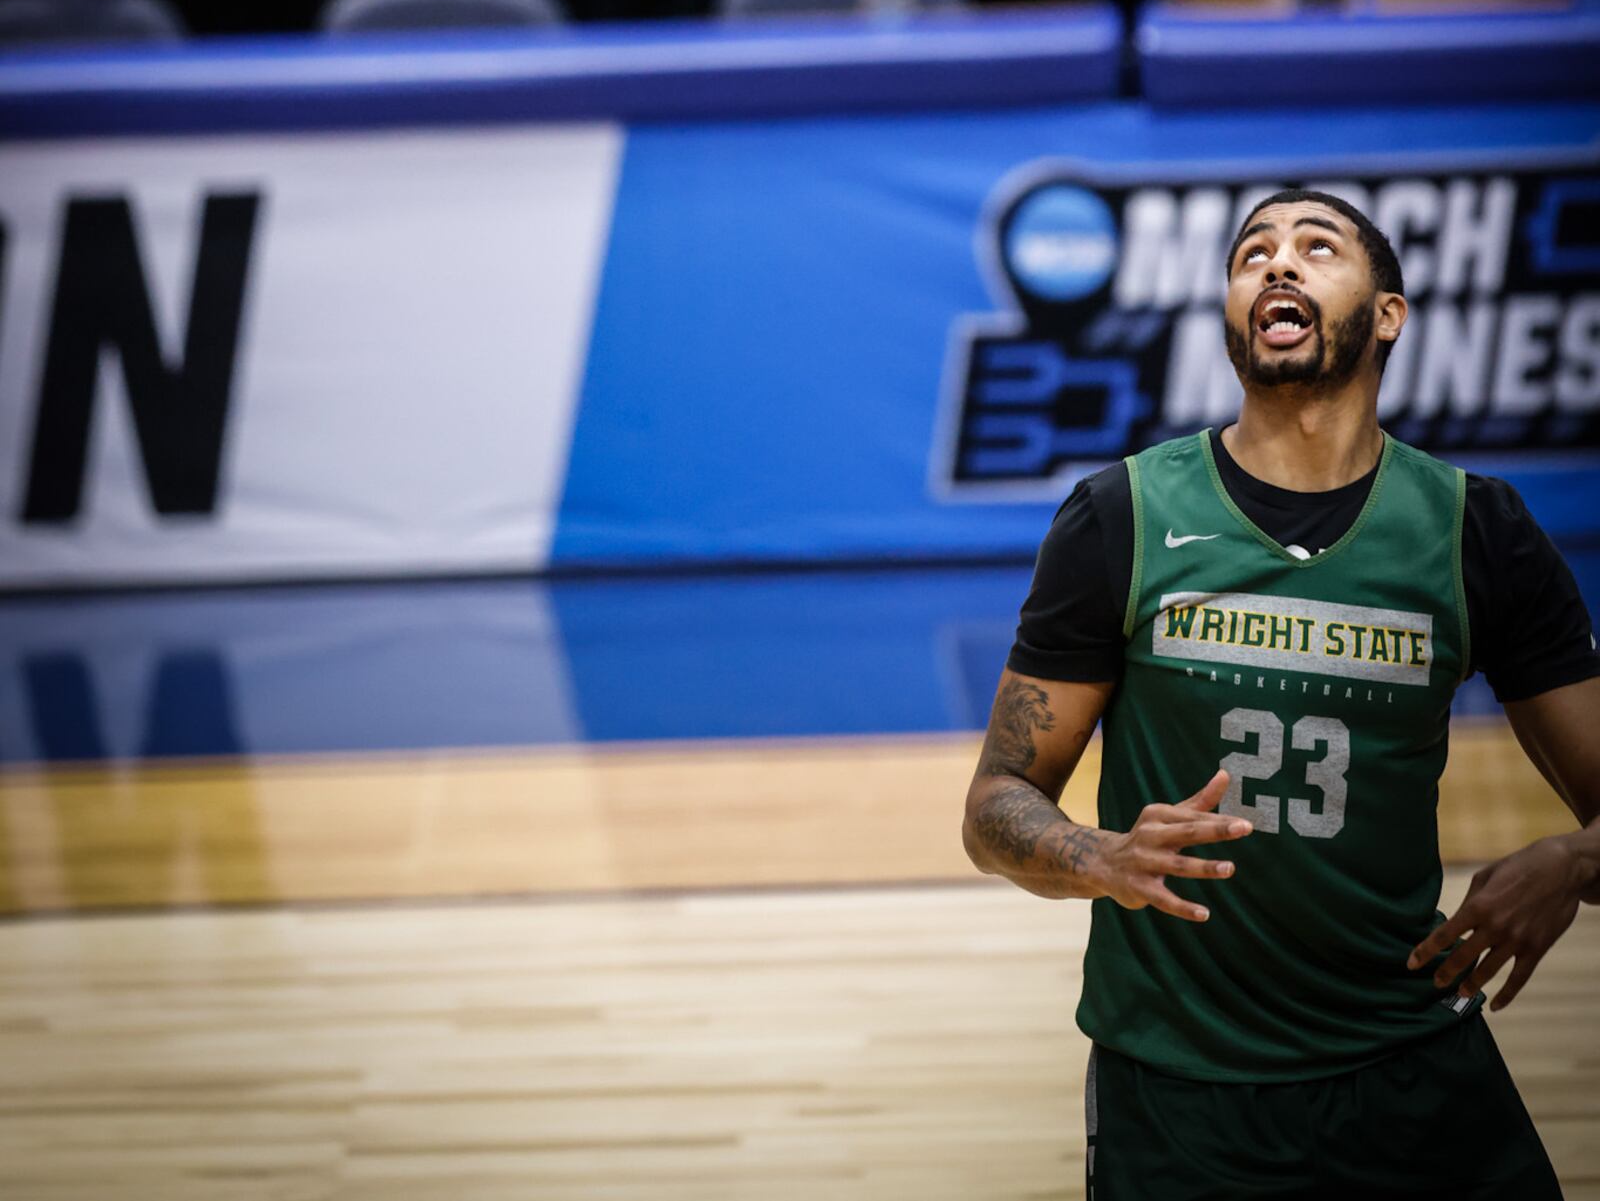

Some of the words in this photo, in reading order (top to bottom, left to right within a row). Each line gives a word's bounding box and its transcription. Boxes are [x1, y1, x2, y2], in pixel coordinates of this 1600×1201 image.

[1115, 176, 1516, 312] MCH
[0, 186, 265, 530] N
[1164, 606, 1315, 653] WRIGHT
[1325, 622, 1427, 668] STATE
[1185, 667, 1393, 703] BASKETBALL
[1218, 707, 1351, 839] 23
